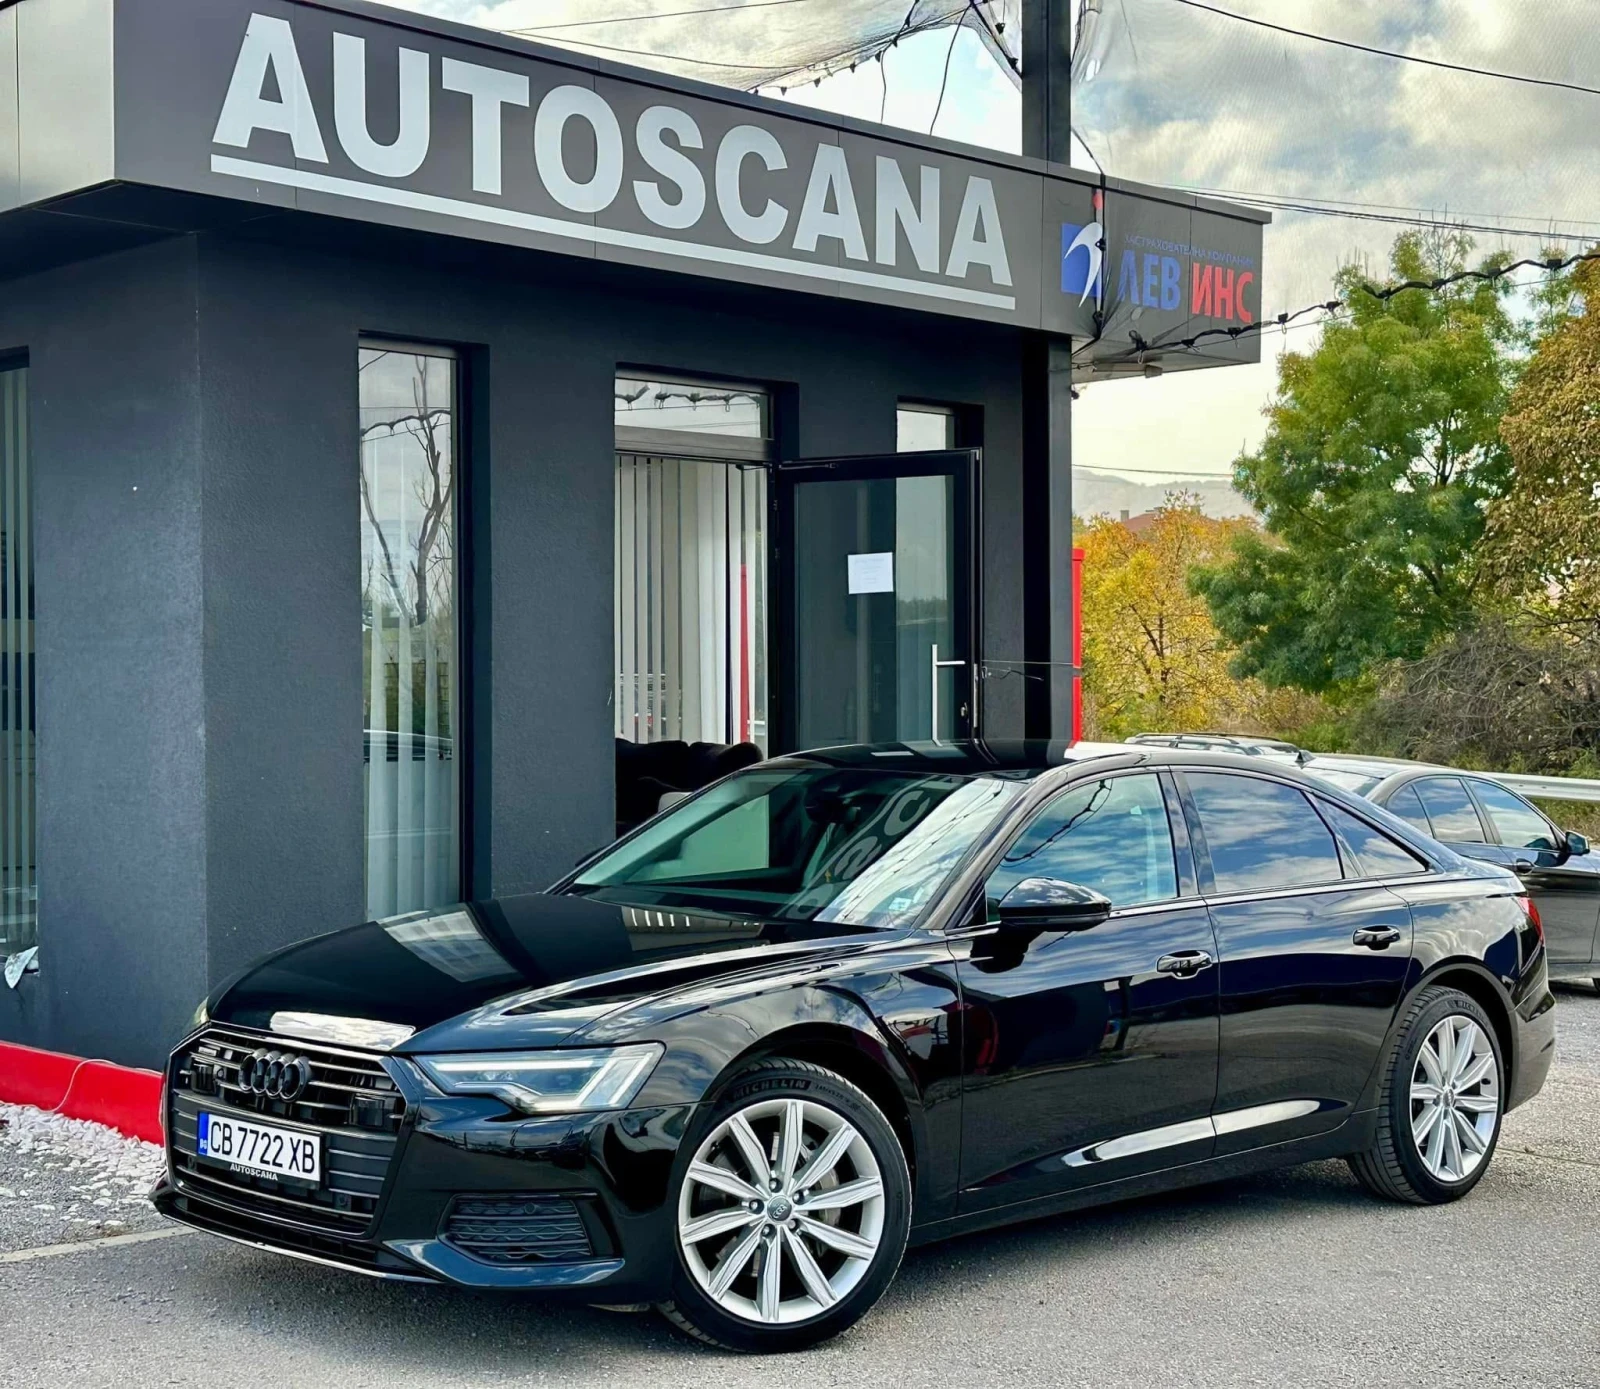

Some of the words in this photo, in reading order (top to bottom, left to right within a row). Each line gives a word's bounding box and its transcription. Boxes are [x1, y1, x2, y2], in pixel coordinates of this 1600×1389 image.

[212, 12, 1012, 286] AUTOSCANA
[1118, 250, 1181, 311] ЛЕВ
[1191, 262, 1254, 324] ИНС
[733, 1079, 806, 1099] MICHELIN
[210, 1121, 233, 1156] CB
[236, 1126, 284, 1168] 7722
[288, 1137, 315, 1174] XB
[230, 1163, 279, 1181] AUTOSCANA
